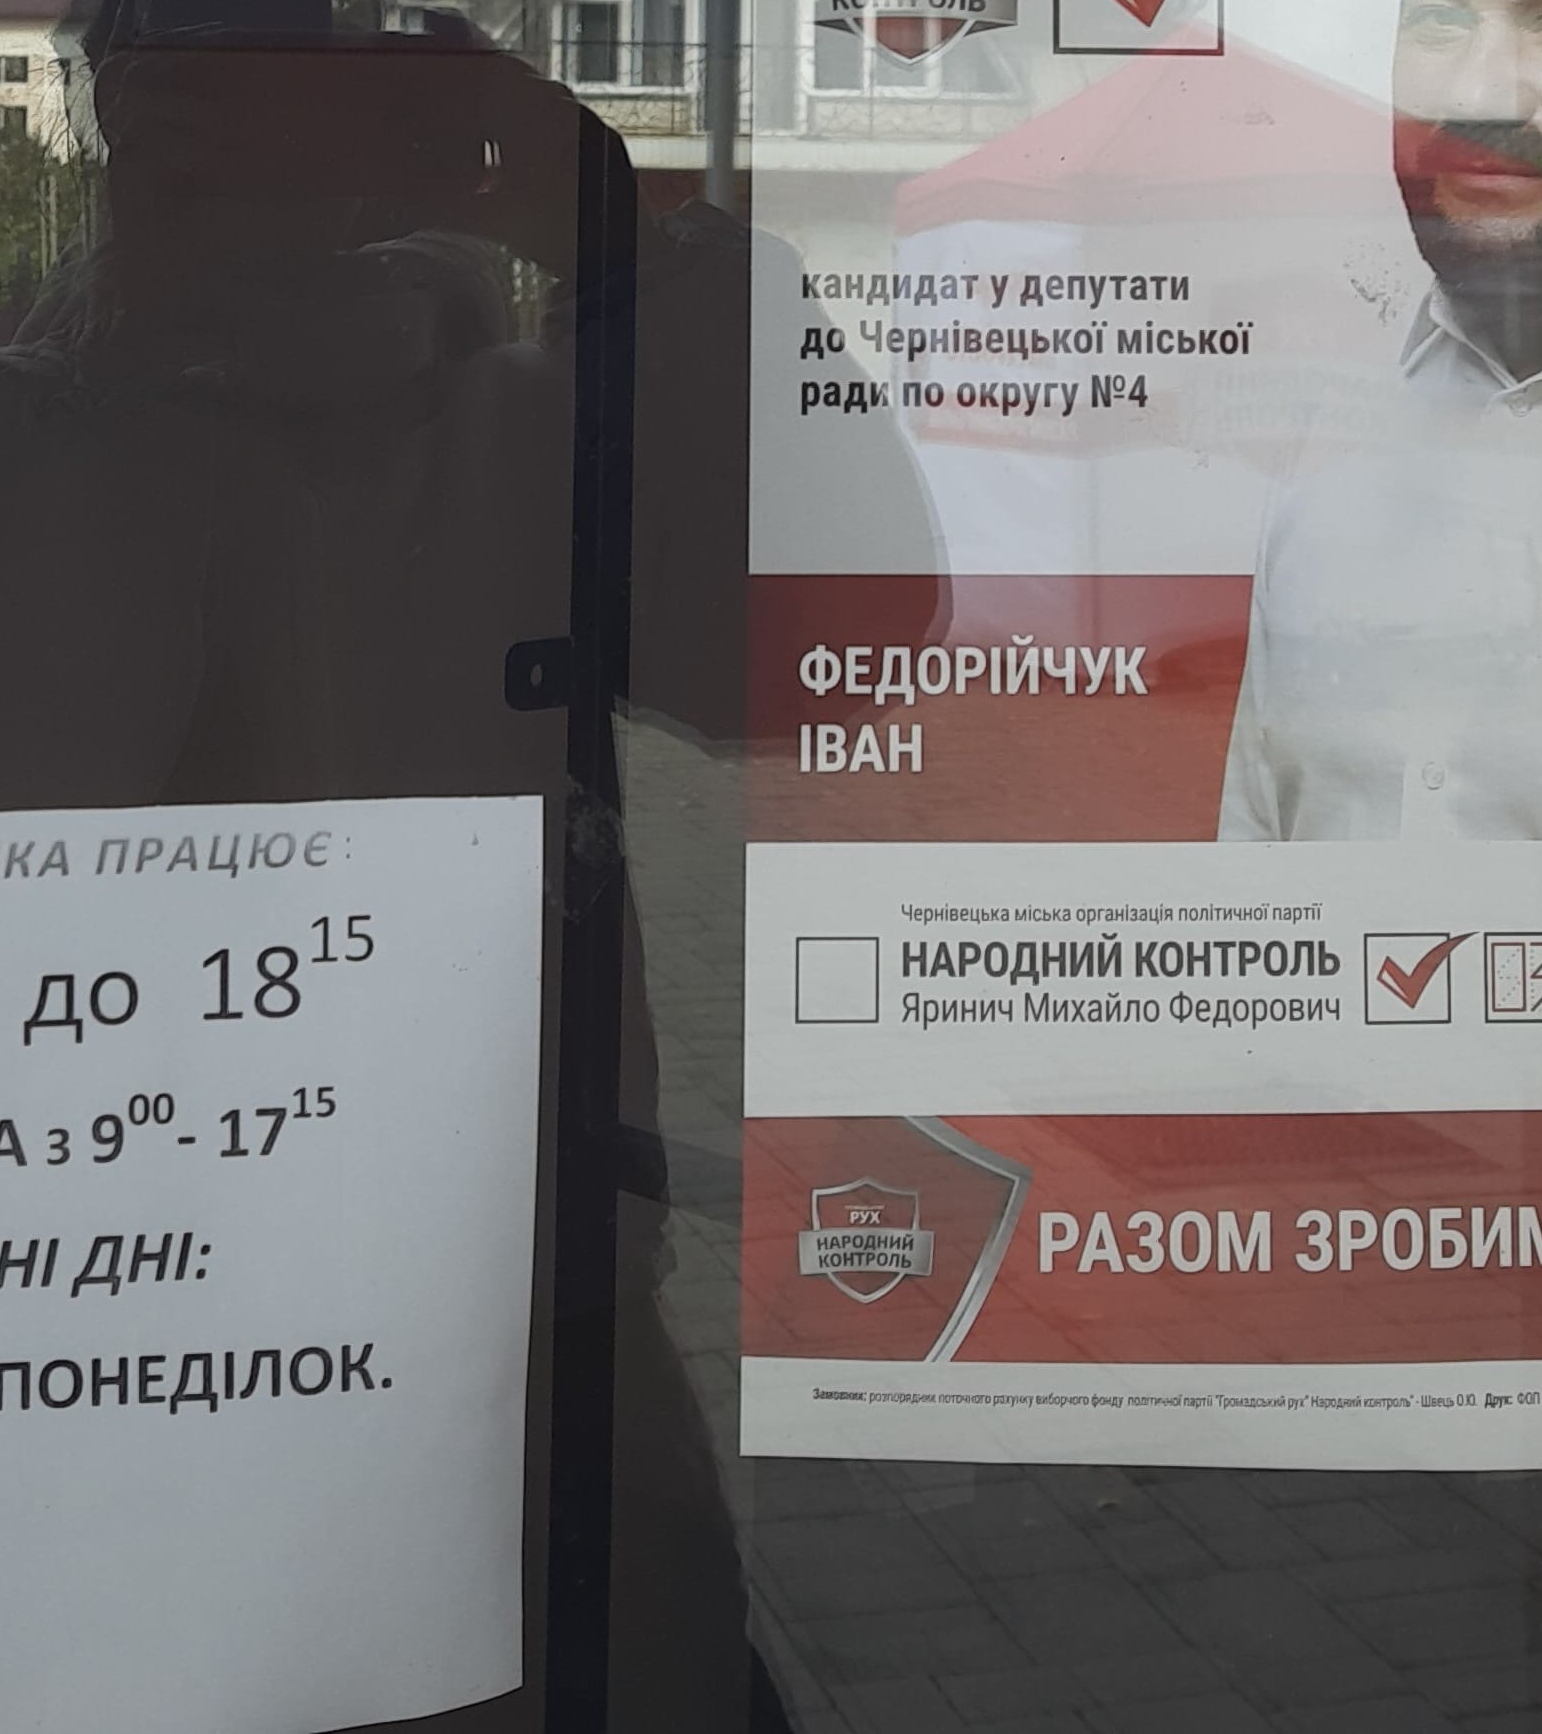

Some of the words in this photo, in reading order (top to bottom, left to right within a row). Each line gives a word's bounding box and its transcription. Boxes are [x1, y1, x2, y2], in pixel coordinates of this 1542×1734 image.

[801, 272, 979, 306] кандидат
[990, 274, 1010, 308] у
[1020, 273, 1190, 308] депутати
[800, 326, 846, 360] до
[859, 319, 1106, 363] Чернівецької
[1117, 320, 1255, 355] міської
[800, 380, 890, 416] ради
[902, 380, 945, 408] по
[956, 380, 1079, 417] округу
[1091, 374, 1149, 409] №4
[798, 634, 1150, 706] ФЕДОРІЙЧУК
[799, 723, 924, 774] ІВАН
[94, 830, 355, 879] ПРАЦЮЄ:
[901, 903, 1011, 925] Чернівецька
[1014, 904, 1072, 923] міська
[1075, 903, 1175, 925] організація
[1177, 902, 1270, 922] політичної
[1272, 901, 1323, 925] партії
[902, 933, 1123, 986] НАРОДНИЙ
[1135, 940, 1342, 978] КОНТРОЛЬ
[22, 972, 141, 1045] до
[901, 992, 1014, 1030] Яринич
[1023, 990, 1161, 1024] Михайло
[1168, 989, 1342, 1030] Федорович
[848, 1210, 882, 1225] РУХ
[817, 1233, 915, 1252] НАРОДНИЙ
[818, 1251, 913, 1269] КОНТРОЛЬ
[1038, 1208, 1273, 1276] РАЗОМ
[71, 1231, 213, 1299] ДНІ:
